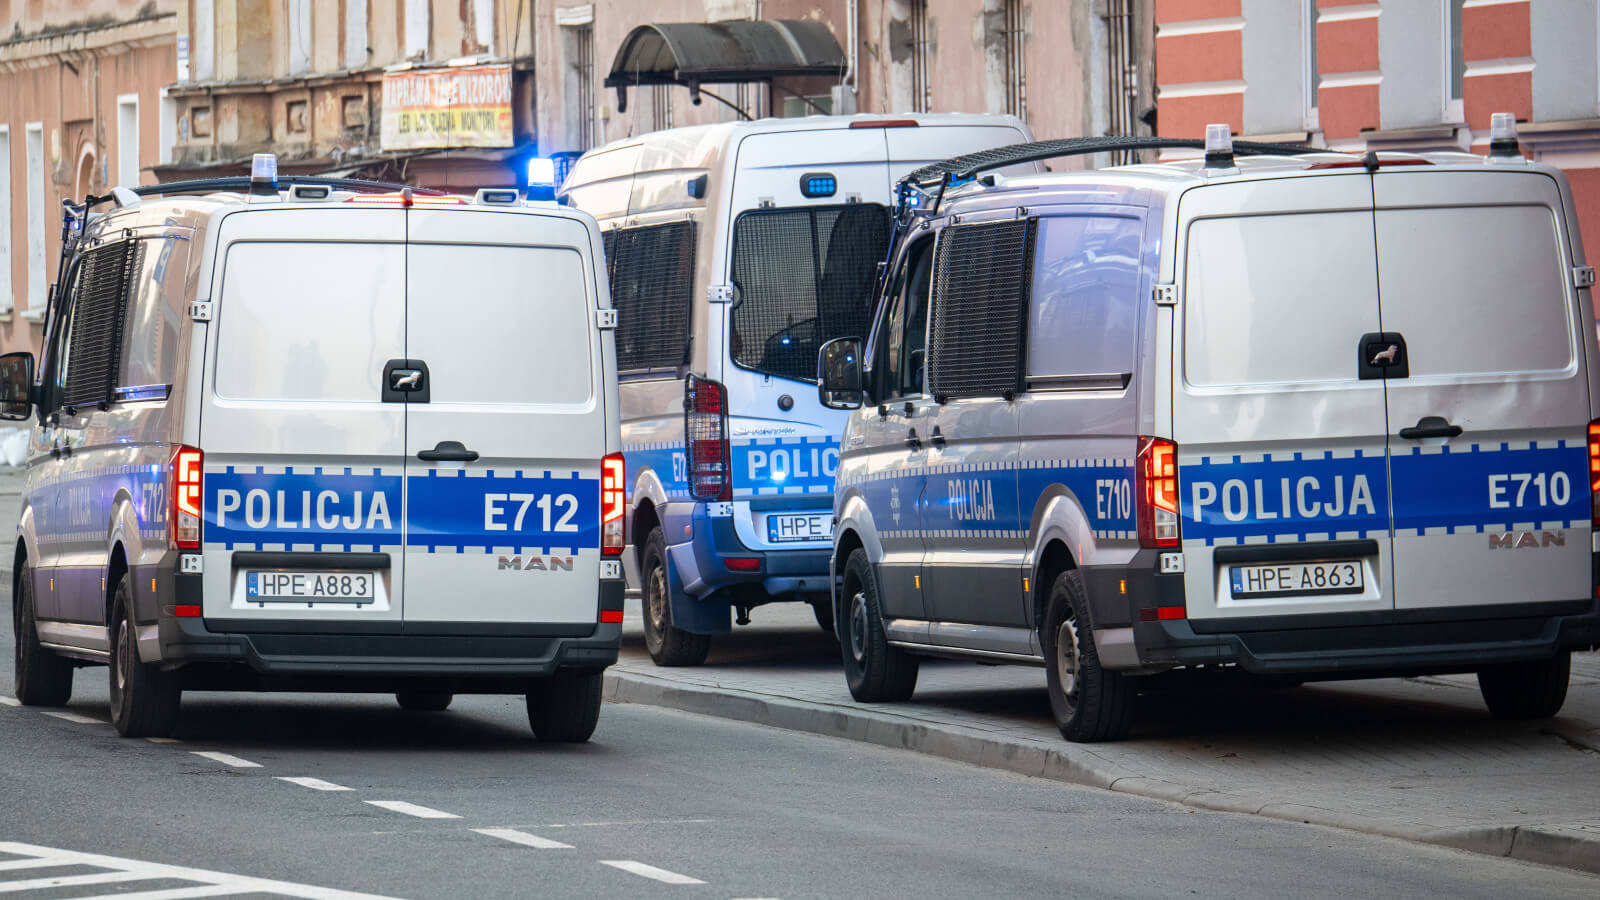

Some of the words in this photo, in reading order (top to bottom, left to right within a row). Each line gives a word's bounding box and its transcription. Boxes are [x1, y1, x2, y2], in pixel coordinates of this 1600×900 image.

[383, 77, 431, 106] NAPRAWA
[142, 482, 164, 523] E712
[217, 488, 393, 530] POLICJA
[948, 479, 996, 521] POLICJA
[1096, 478, 1131, 520] E710
[1191, 474, 1376, 523] POLICJA
[1488, 471, 1571, 509] E710
[484, 493, 579, 532] E712
[781, 516, 822, 536] HPE
[1488, 531, 1566, 550] MAN
[497, 555, 574, 571] MAN
[1247, 567, 1292, 591] HPE
[1301, 565, 1356, 588] A863
[263, 574, 305, 595] HPE
[313, 575, 367, 596] A883
